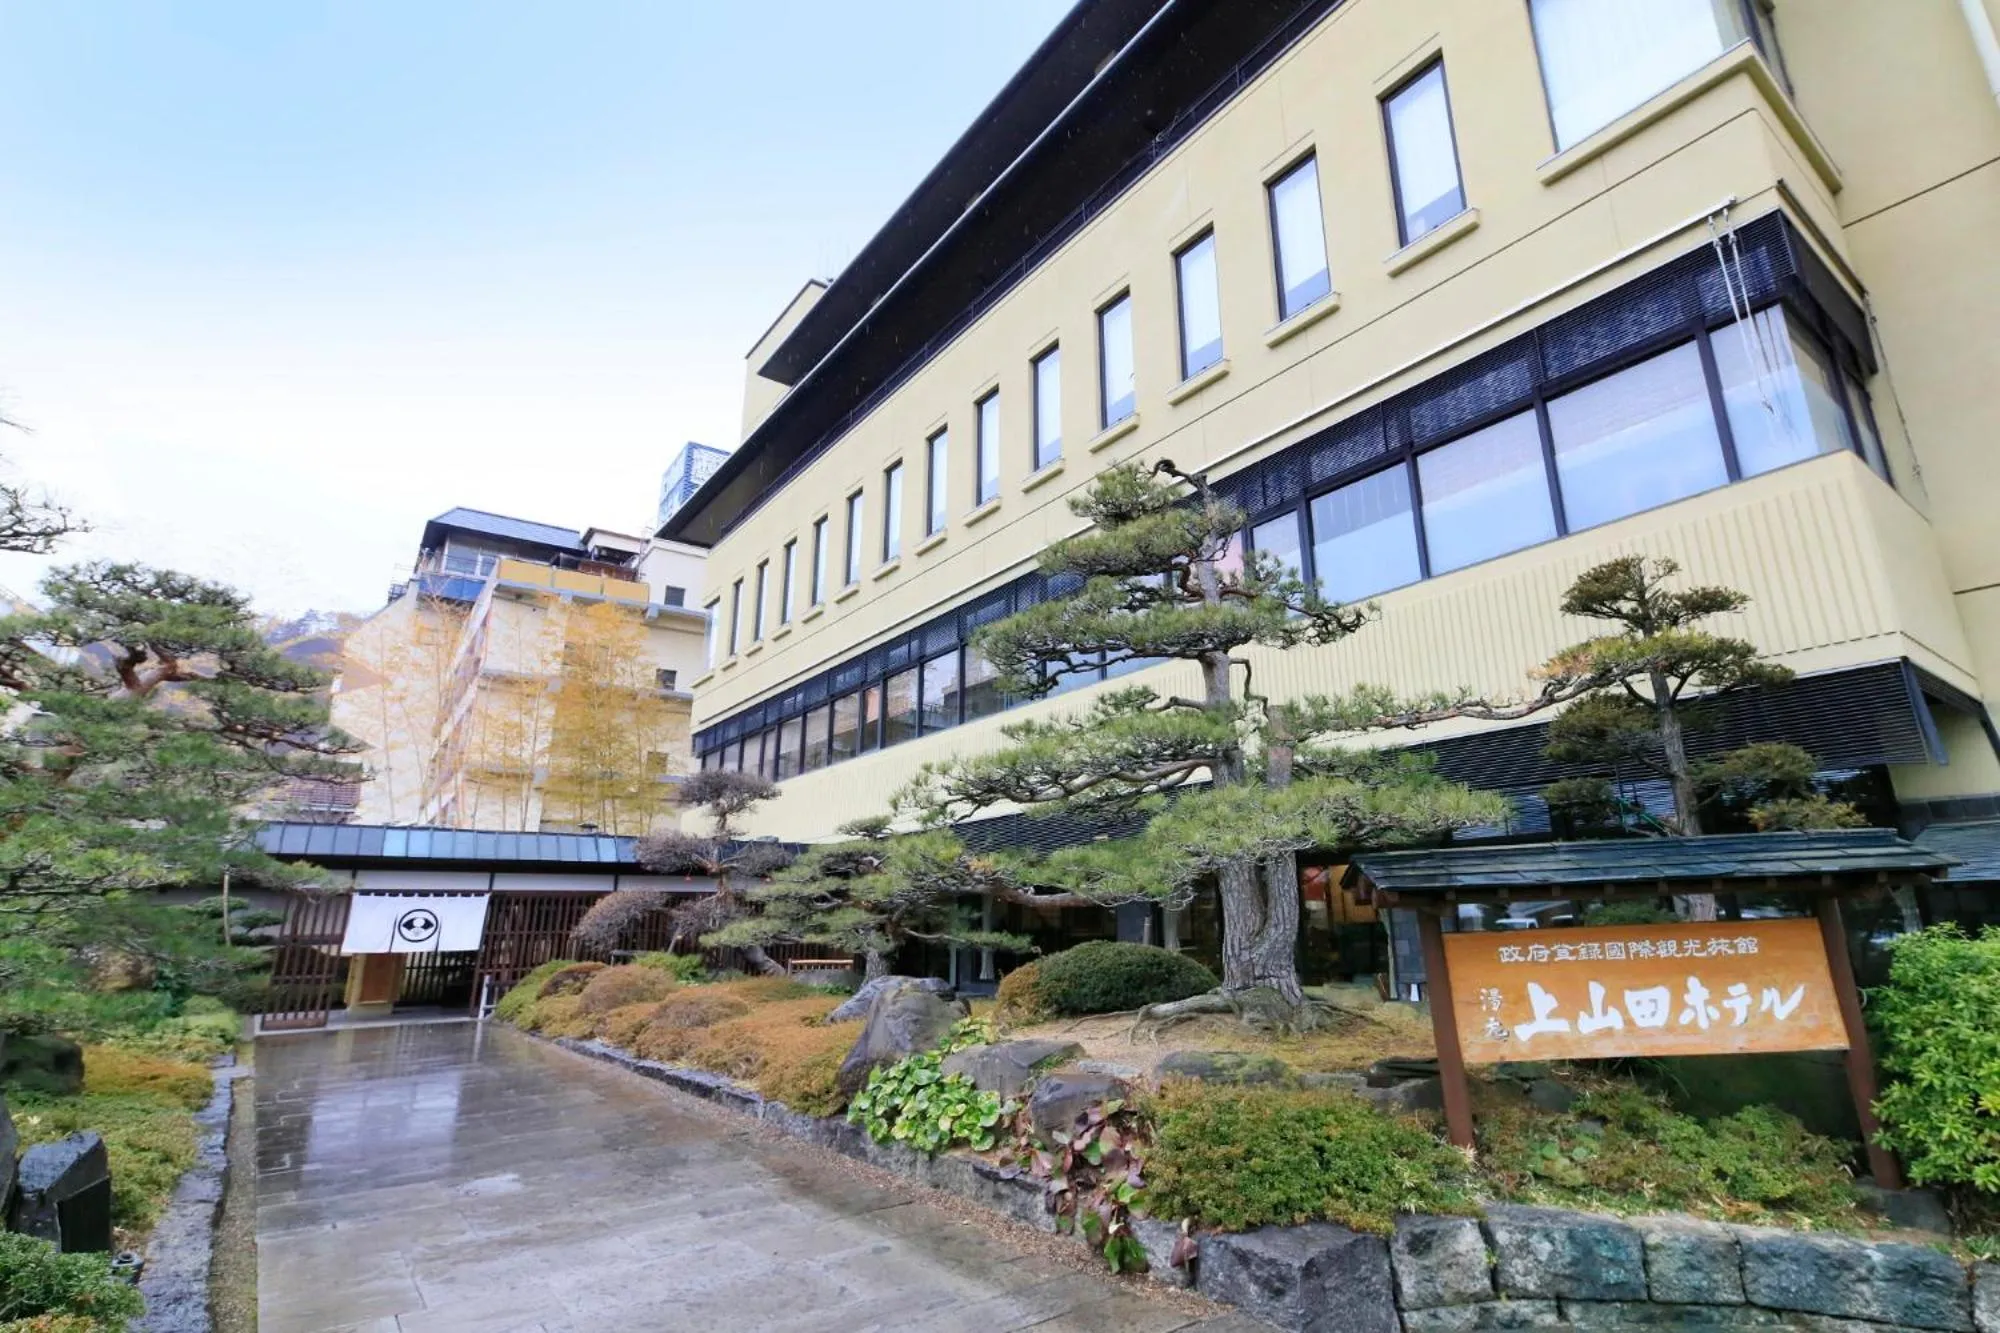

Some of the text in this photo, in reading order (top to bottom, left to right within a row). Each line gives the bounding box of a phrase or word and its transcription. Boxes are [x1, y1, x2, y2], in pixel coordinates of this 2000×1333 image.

[1513, 976, 1805, 1041] 上山田ホテル
